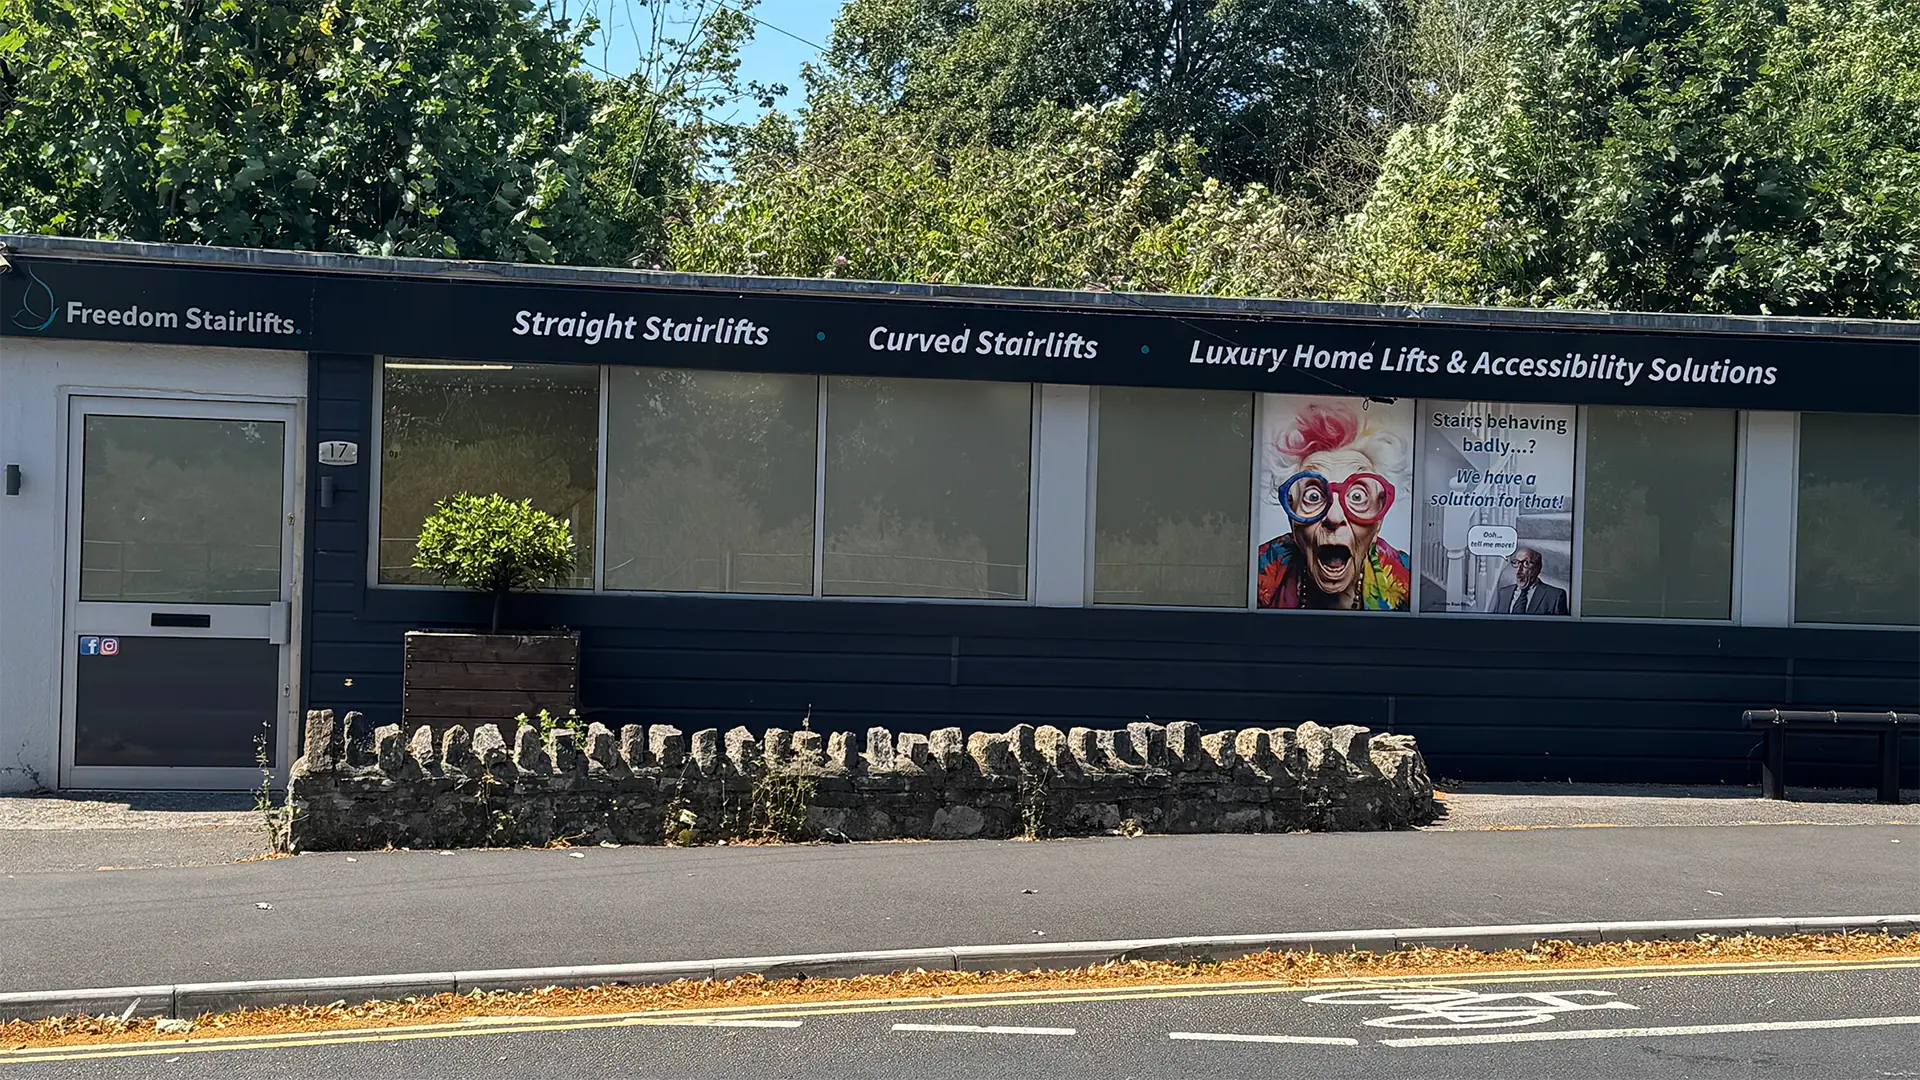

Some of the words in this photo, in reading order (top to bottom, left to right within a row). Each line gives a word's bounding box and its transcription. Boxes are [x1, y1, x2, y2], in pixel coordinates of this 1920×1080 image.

[66, 301, 178, 328] Freedom
[512, 310, 637, 345] Straight
[642, 316, 770, 346] Stairlifts
[868, 326, 971, 353] Curved
[976, 330, 1099, 359] Stairlifts
[1189, 340, 1288, 373] Luxury
[1293, 344, 1374, 371] Home
[1380, 347, 1440, 374] Lifts
[1446, 350, 1467, 374] &
[1471, 351, 1643, 386] Accessibility
[1648, 357, 1778, 385] Solutions
[1433, 412, 1482, 428] Stairs
[1487, 413, 1568, 434] behaving
[329, 443, 348, 458] 17
[1463, 437, 1537, 456] badly...?
[1457, 469, 1481, 484] We
[1484, 470, 1523, 486] have
[1526, 474, 1537, 486] a
[1430, 491, 1494, 507] solution
[1497, 492, 1522, 508] for
[1524, 494, 1565, 509] that!
[1470, 540, 1483, 548] tell
[1494, 541, 1515, 549] more!
